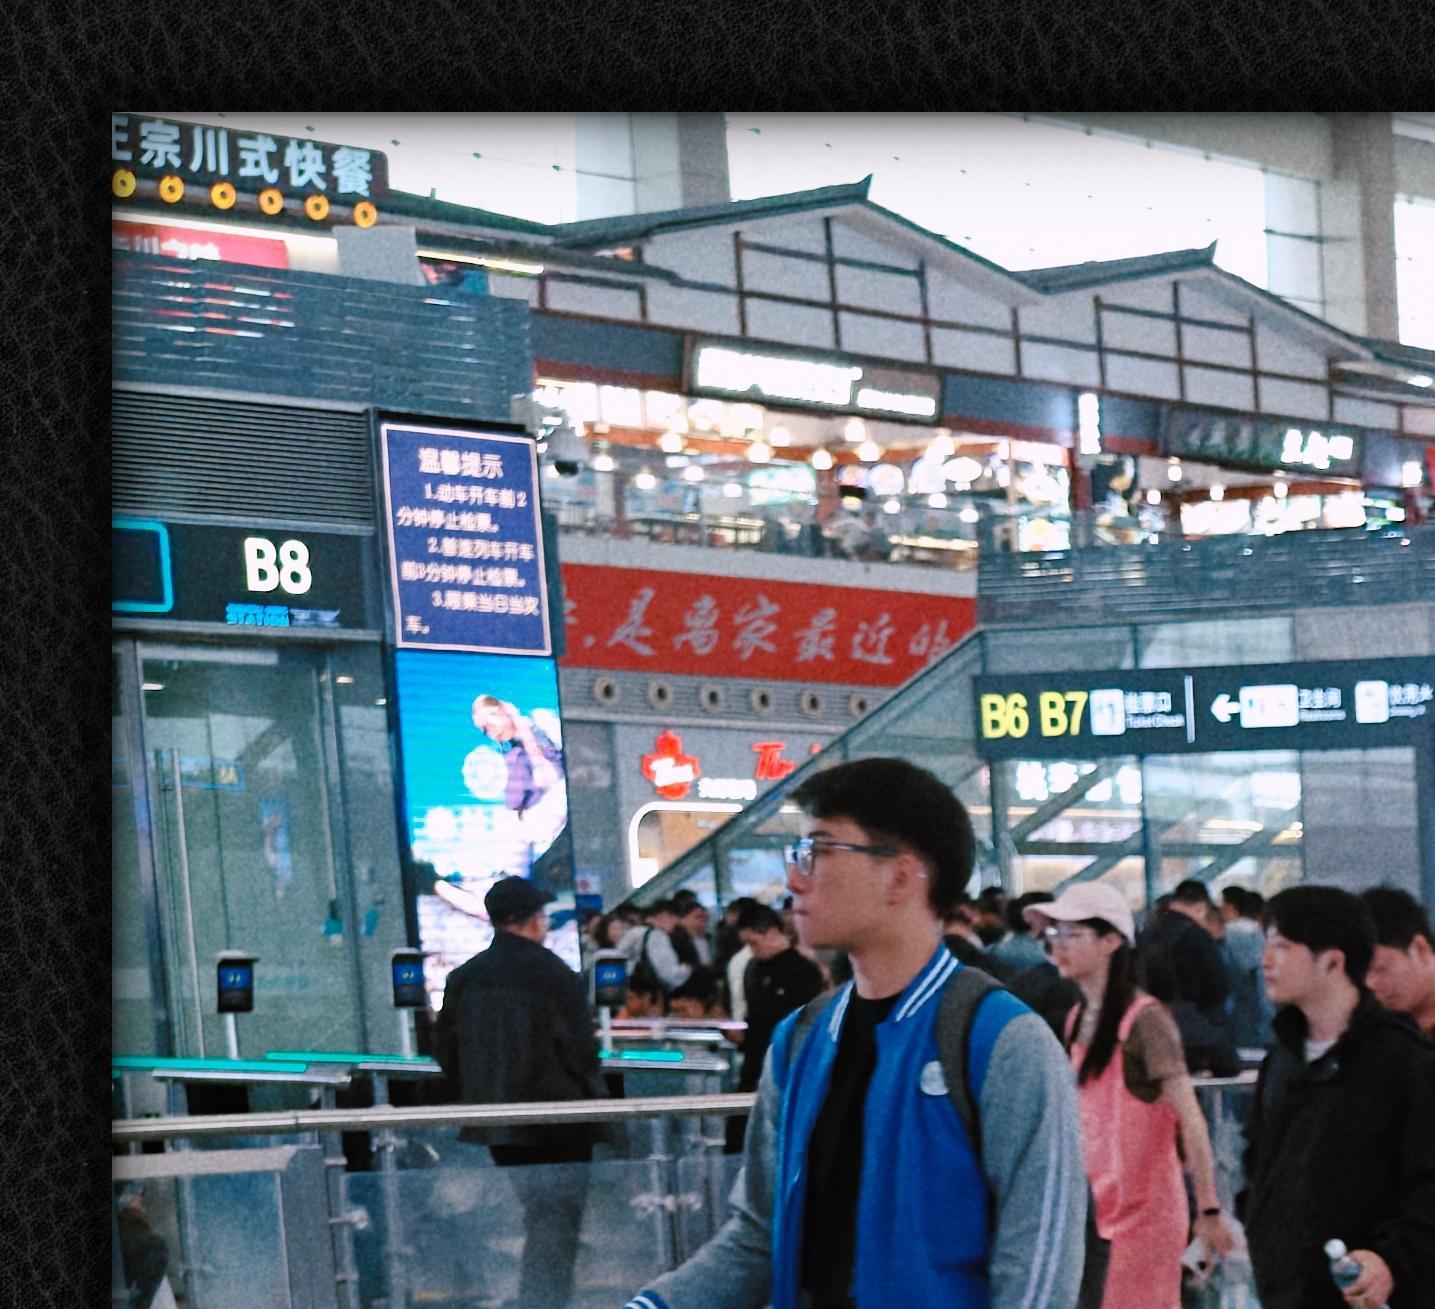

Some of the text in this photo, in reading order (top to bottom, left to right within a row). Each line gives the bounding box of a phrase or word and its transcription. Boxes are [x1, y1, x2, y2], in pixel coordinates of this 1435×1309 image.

[244, 537, 312, 594] B8
[981, 690, 1088, 738] B6 B7
